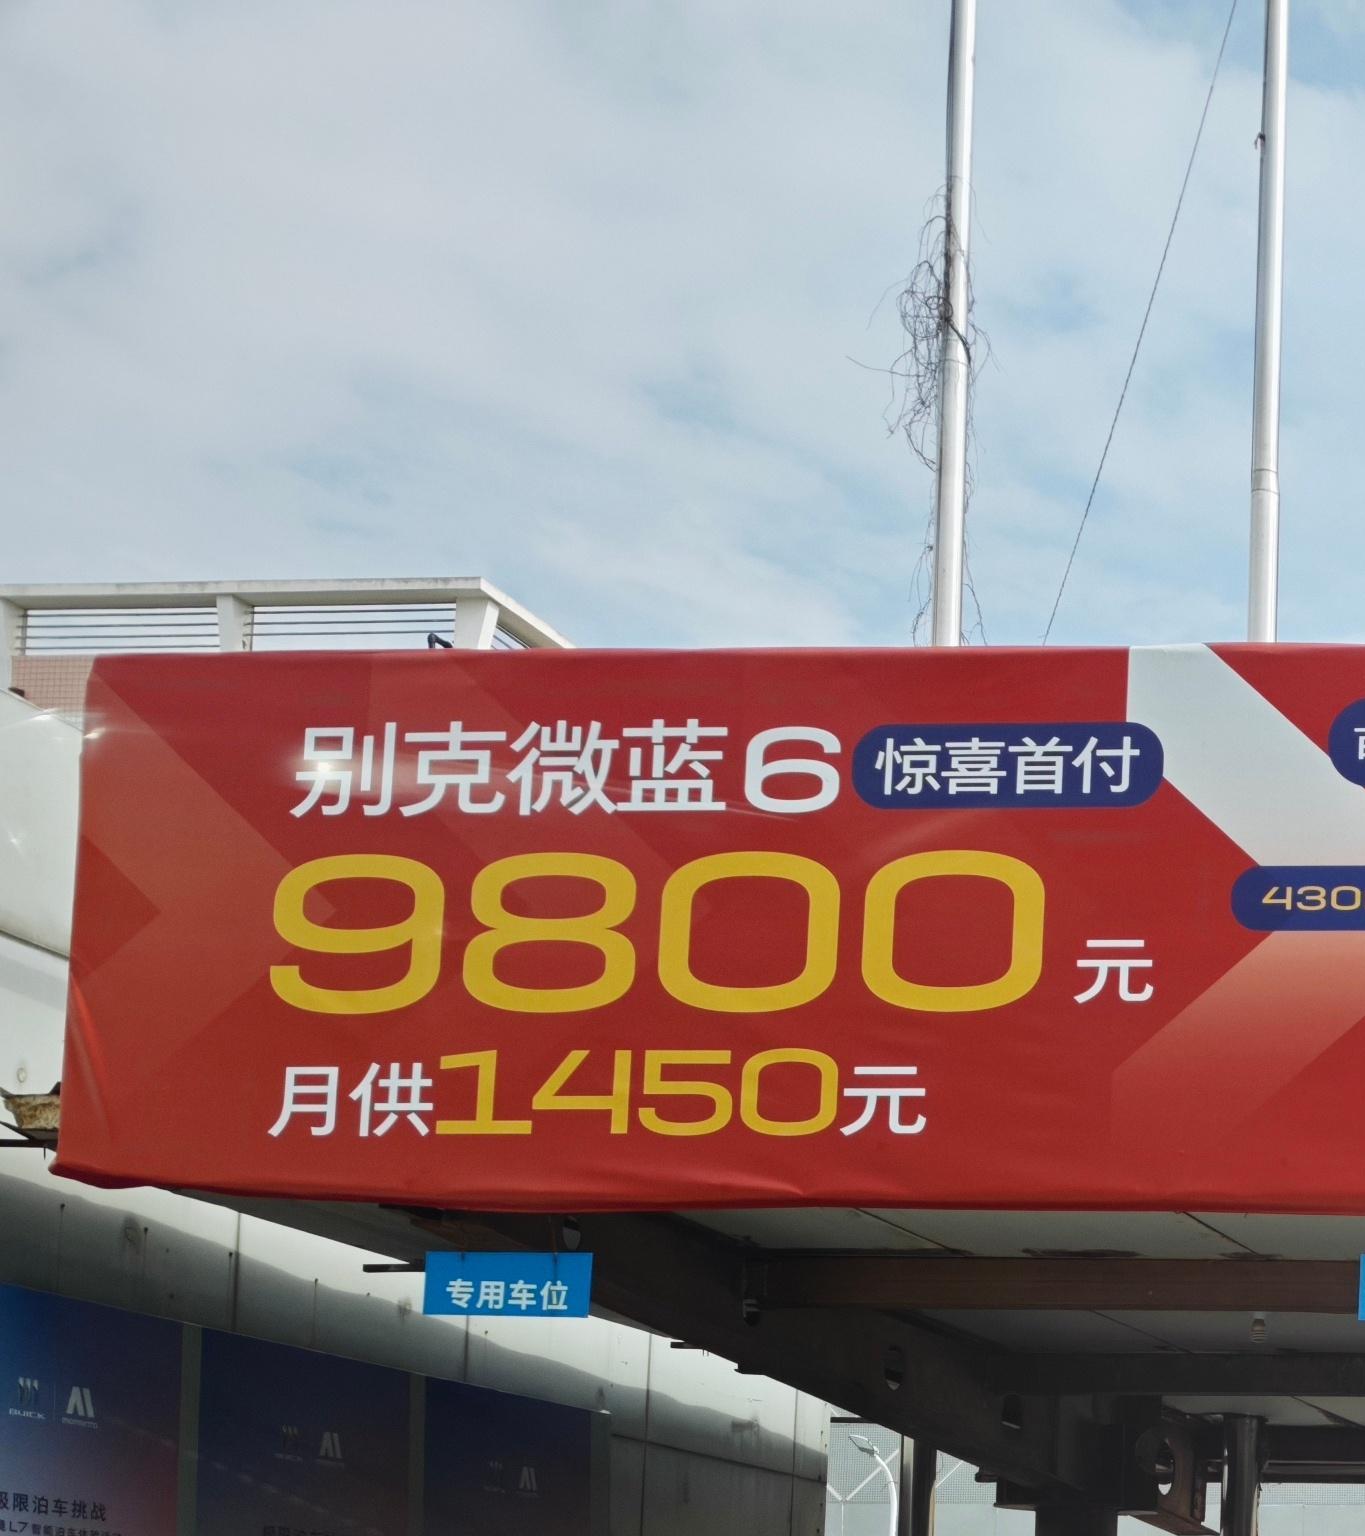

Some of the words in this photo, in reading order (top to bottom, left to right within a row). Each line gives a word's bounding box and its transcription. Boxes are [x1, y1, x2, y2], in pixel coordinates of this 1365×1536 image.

[290, 718, 842, 817] 别克微蓝6
[876, 737, 1140, 795] 惊喜首付
[445, 1278, 569, 1312] 专用车位
